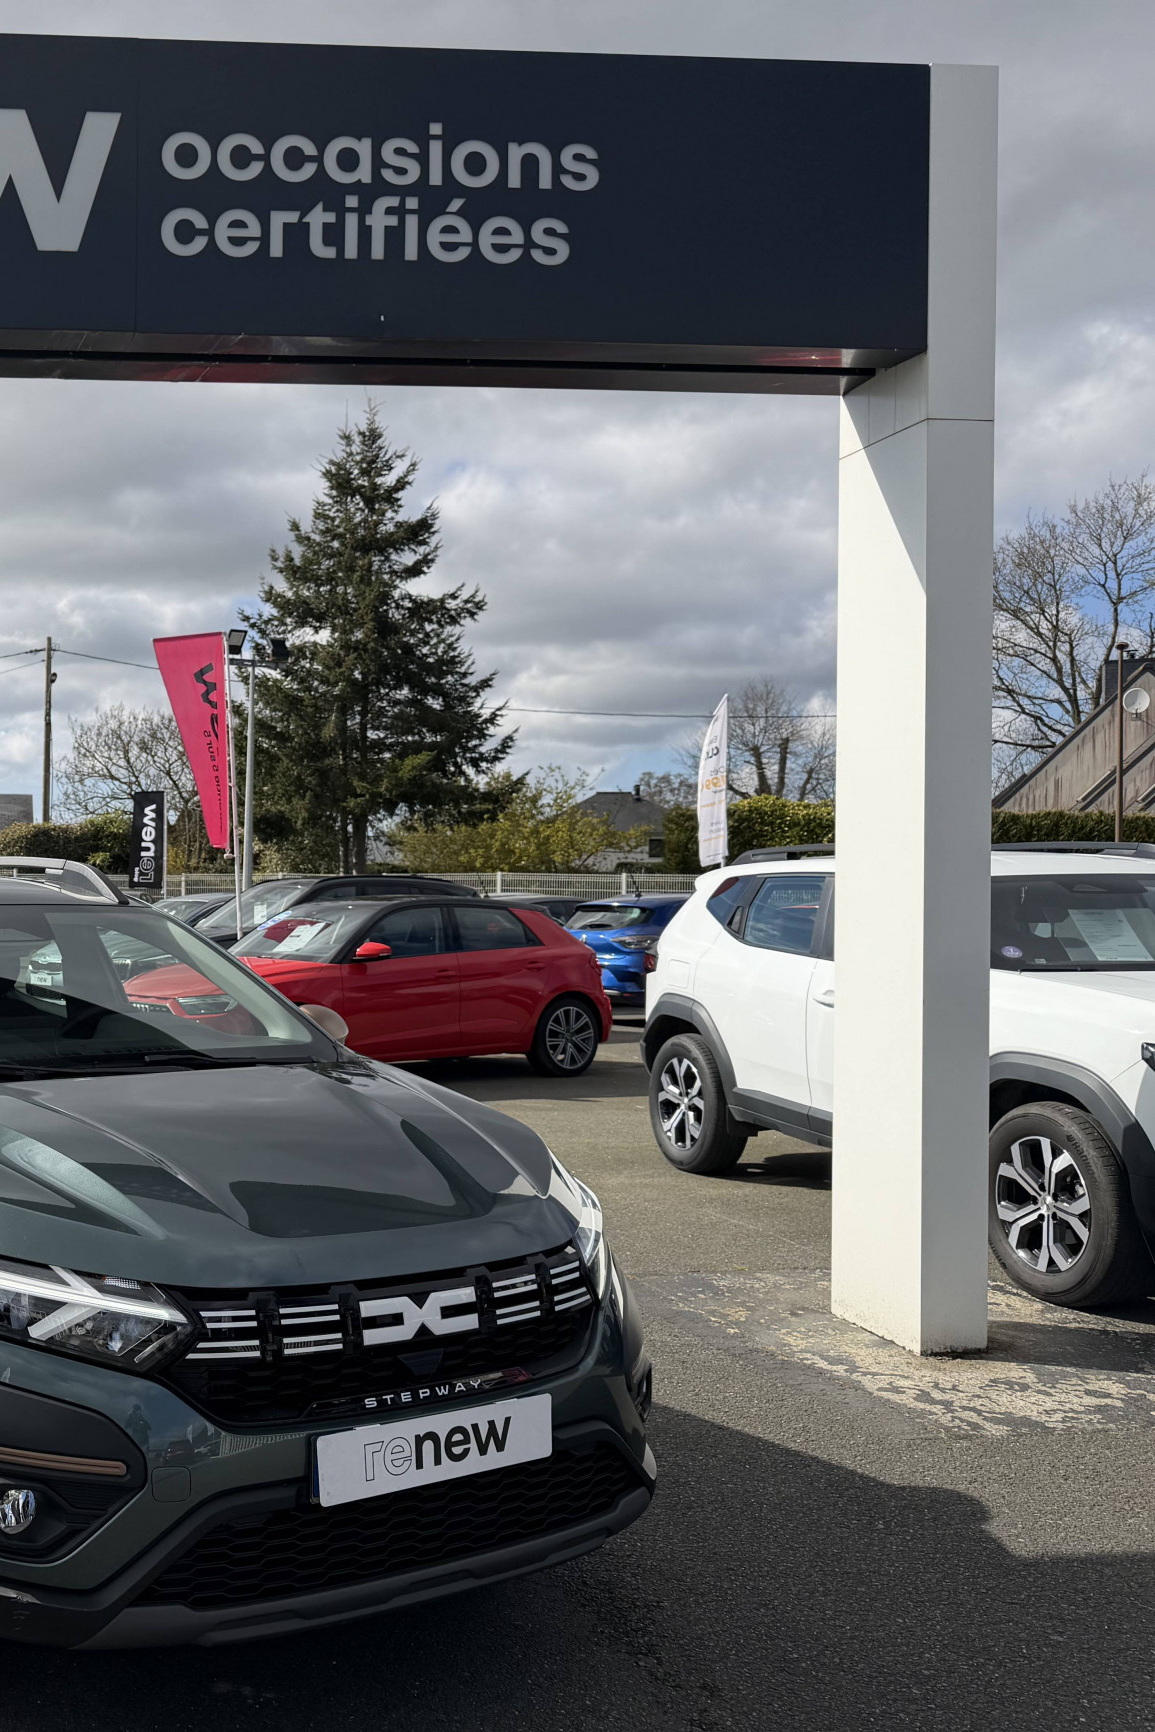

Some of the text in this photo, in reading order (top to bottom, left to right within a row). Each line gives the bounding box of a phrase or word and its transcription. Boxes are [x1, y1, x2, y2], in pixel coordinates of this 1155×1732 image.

[160, 121, 601, 193] occasions
[160, 194, 572, 268] certifiées
[364, 1379, 482, 1408] STEPWAY
[363, 1415, 513, 1483] renew
